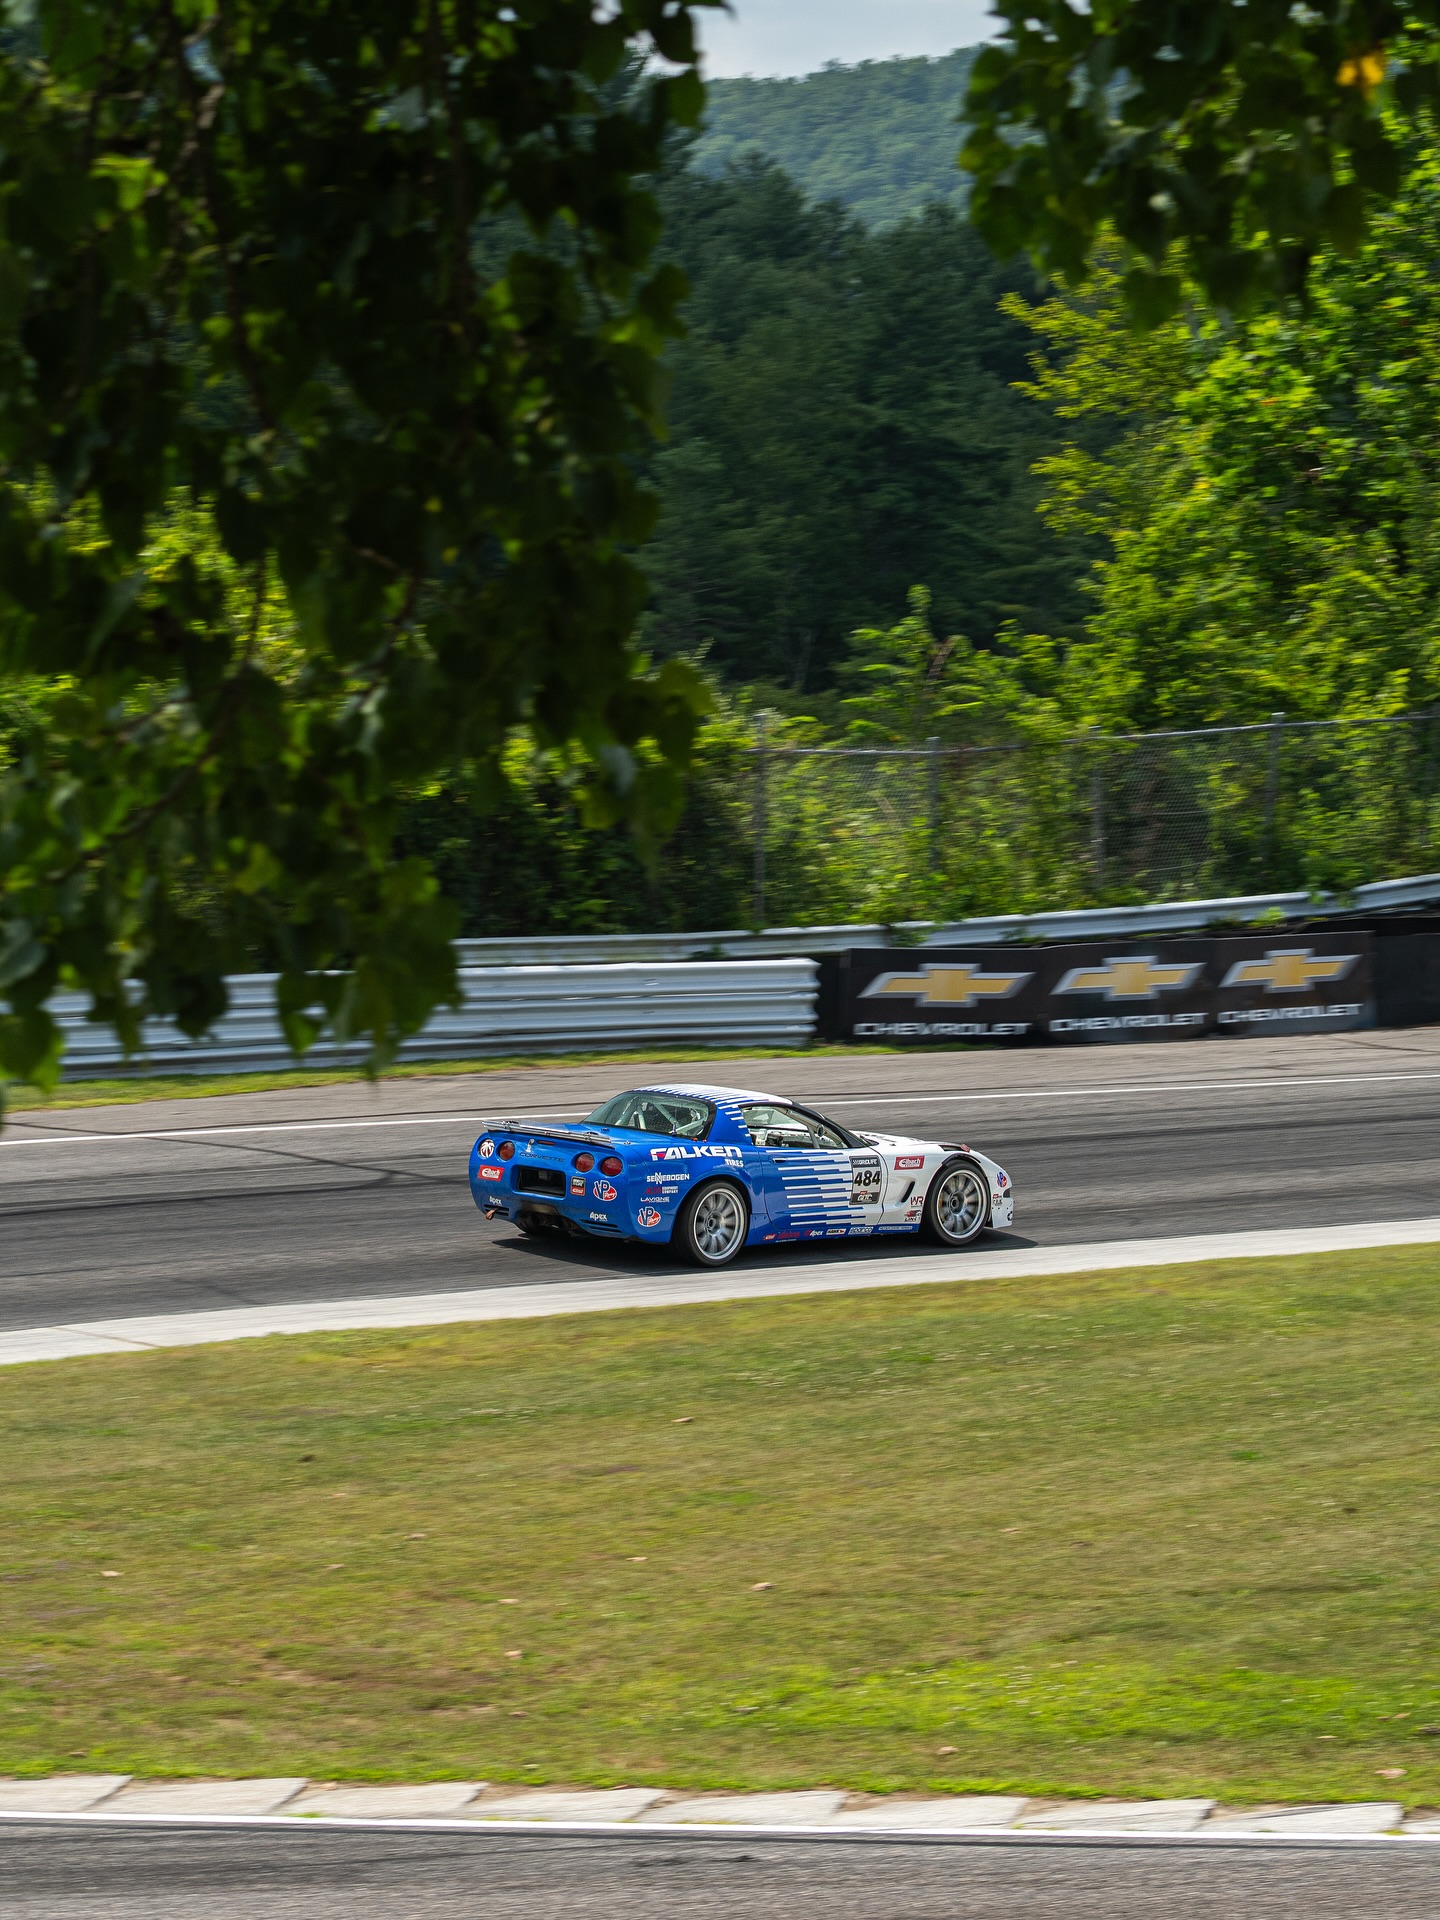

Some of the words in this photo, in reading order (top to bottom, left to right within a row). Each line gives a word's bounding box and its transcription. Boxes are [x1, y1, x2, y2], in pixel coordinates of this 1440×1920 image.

[1217, 1003, 1363, 1023] CHEVROLET
[853, 1022, 1032, 1036] CHEVROLET
[1049, 1012, 1208, 1032] CHEVROLET
[519, 1152, 564, 1162] CORVETTE
[649, 1146, 743, 1161] FALKEN
[724, 1159, 744, 1168] TIRES
[853, 1170, 881, 1187] 484
